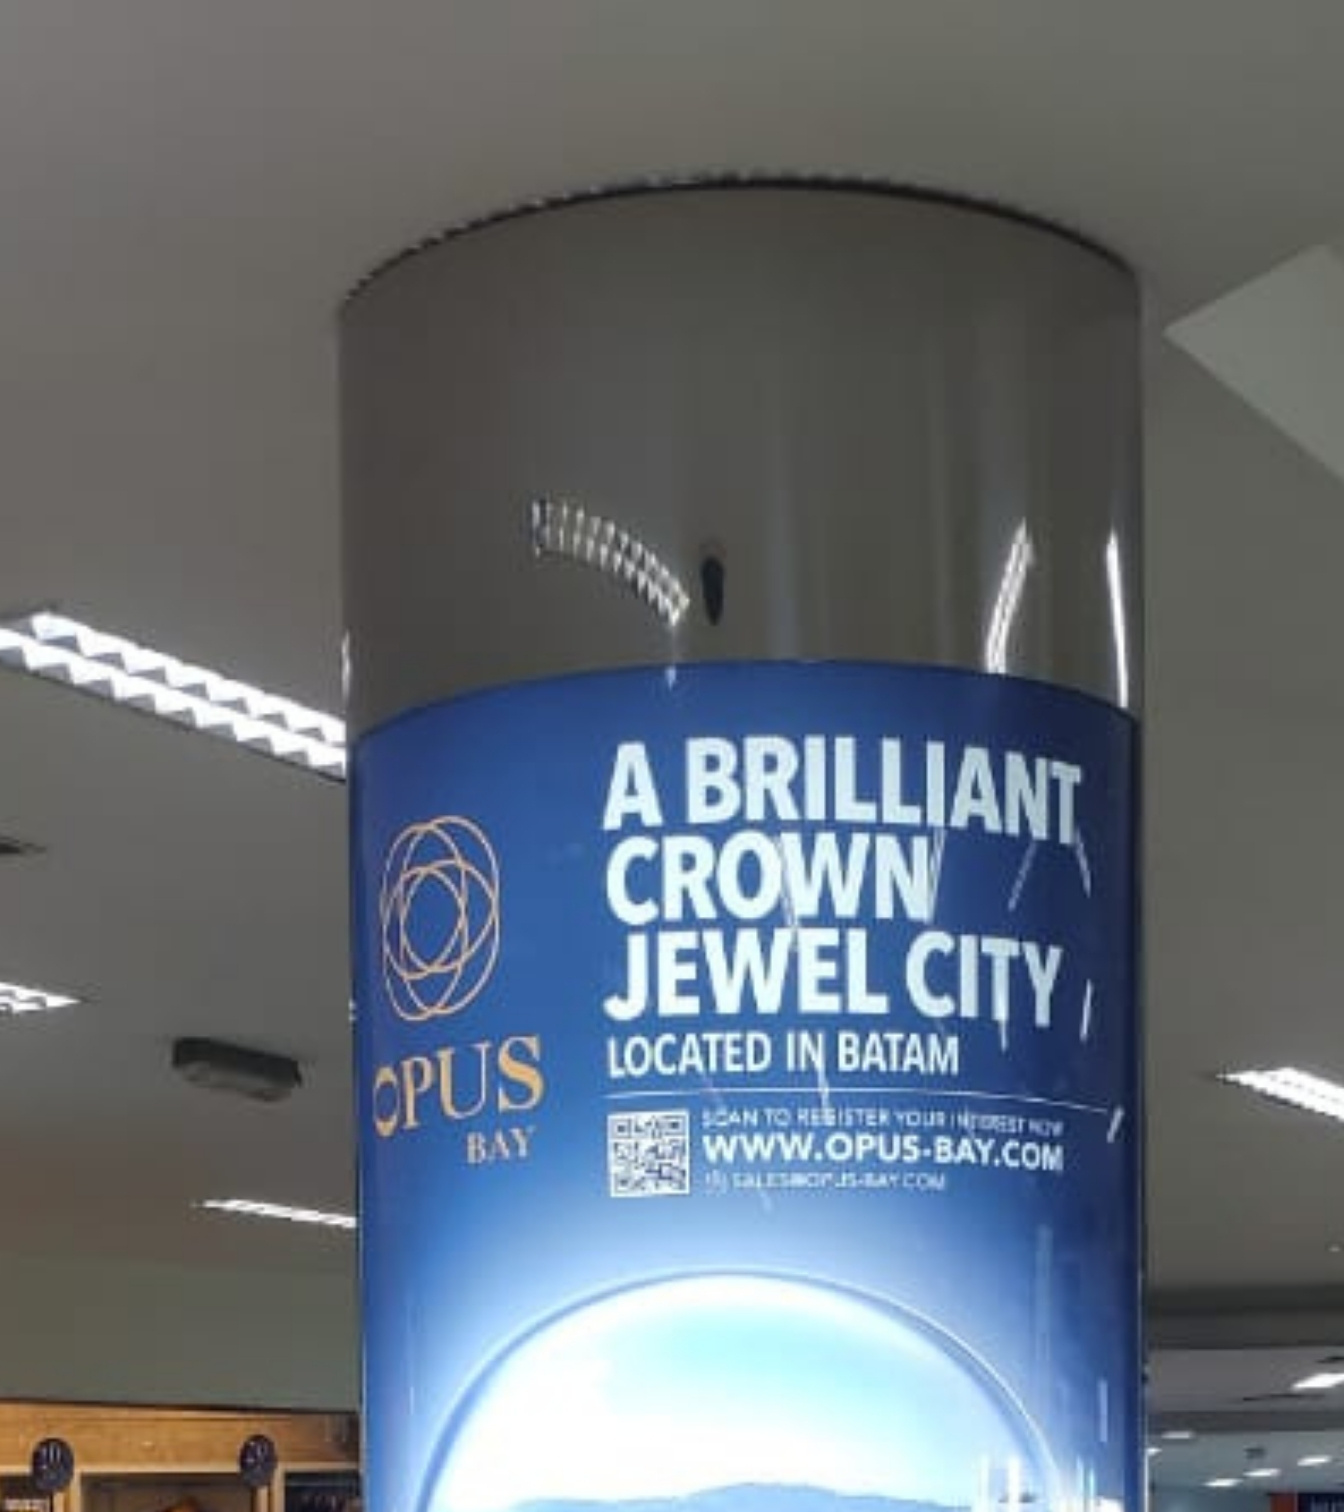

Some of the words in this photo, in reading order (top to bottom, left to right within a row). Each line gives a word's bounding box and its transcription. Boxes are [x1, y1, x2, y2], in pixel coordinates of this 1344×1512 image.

[602, 741, 662, 830] A
[685, 735, 1082, 844] BRILLIANT
[606, 830, 932, 926] CROWN
[603, 928, 890, 1021] JEWEL
[906, 931, 1063, 1027] CITY
[373, 1035, 544, 1137] OPUS
[606, 1033, 772, 1078] LOCATED
[786, 1033, 824, 1073] IN
[837, 1034, 959, 1075] BATAM
[467, 1126, 536, 1164] BAY
[702, 1107, 758, 1129] SCAN
[764, 1107, 791, 1127] TO
[797, 1107, 890, 1127] REGISTER
[894, 1110, 945, 1127] YOUR
[702, 1131, 1065, 1171] WWW.OPUS-BAY.COM
